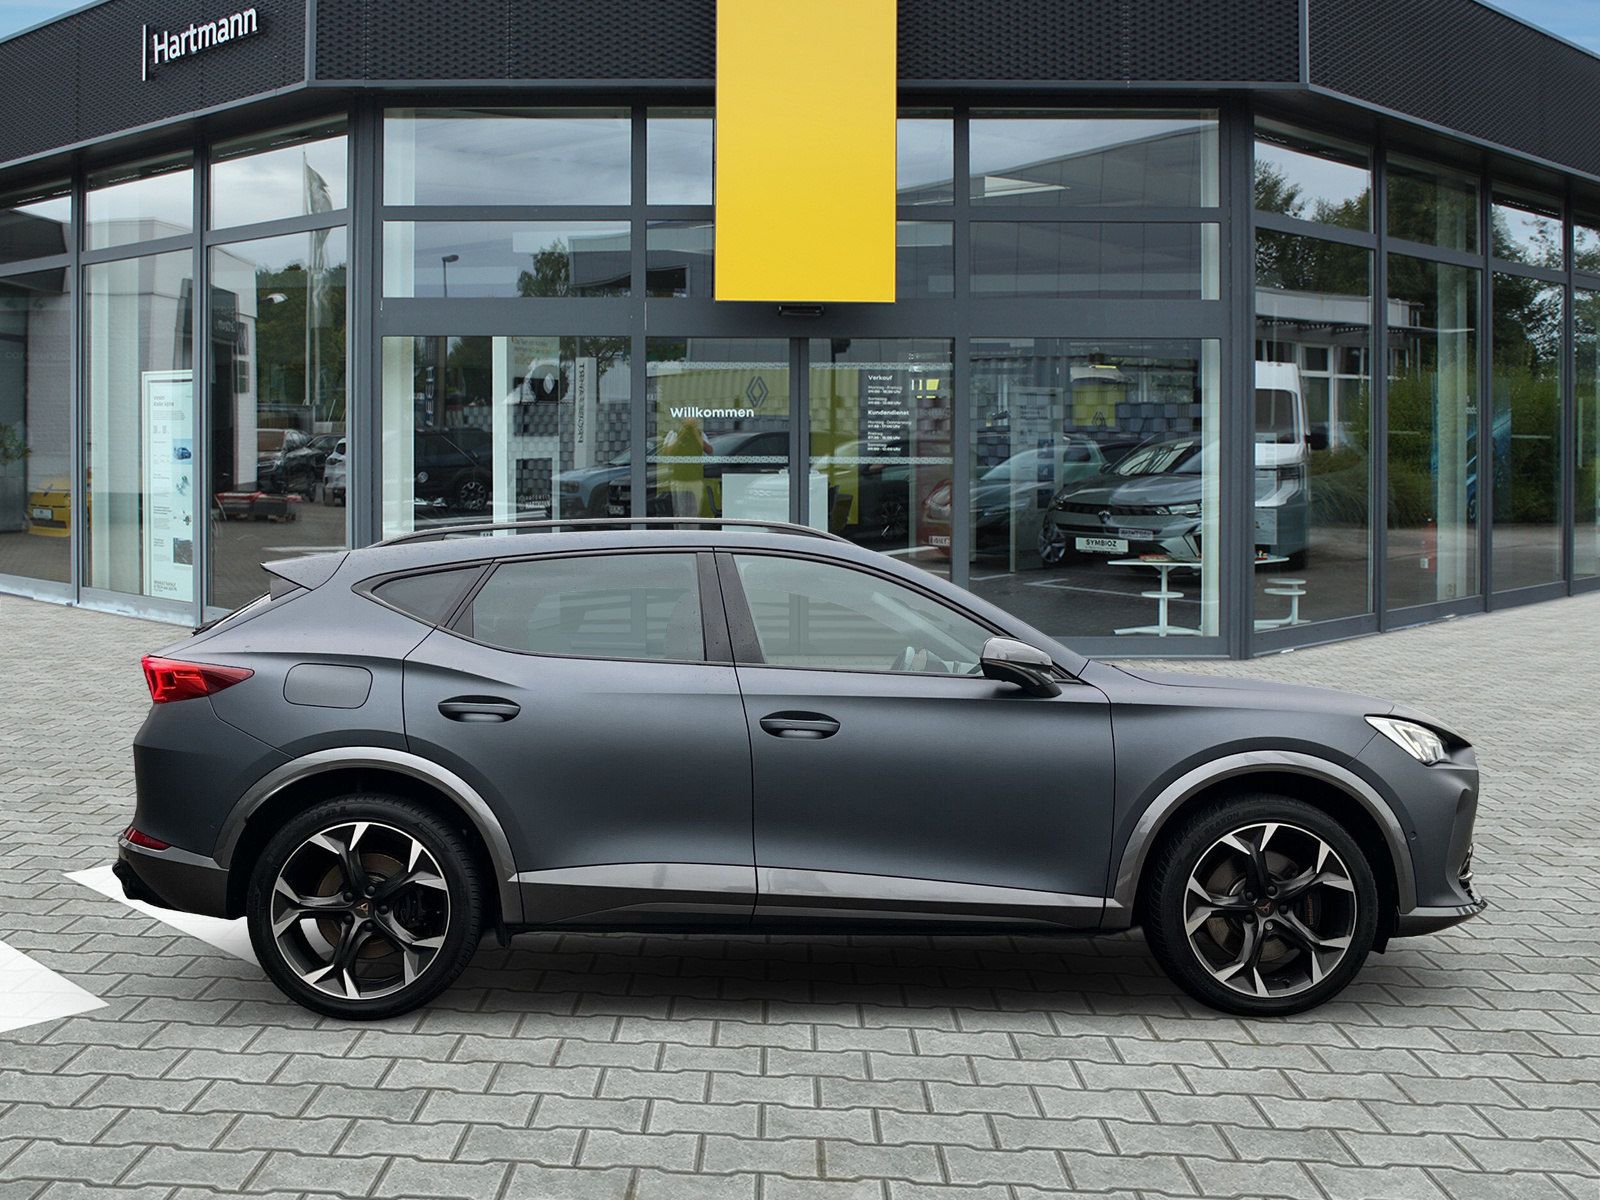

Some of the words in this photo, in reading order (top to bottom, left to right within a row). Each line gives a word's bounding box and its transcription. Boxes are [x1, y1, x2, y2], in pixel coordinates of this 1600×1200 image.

[153, 8, 257, 64] Hartmann
[669, 406, 755, 418] Willkommen
[1086, 538, 1117, 548] SYMBIOZ
